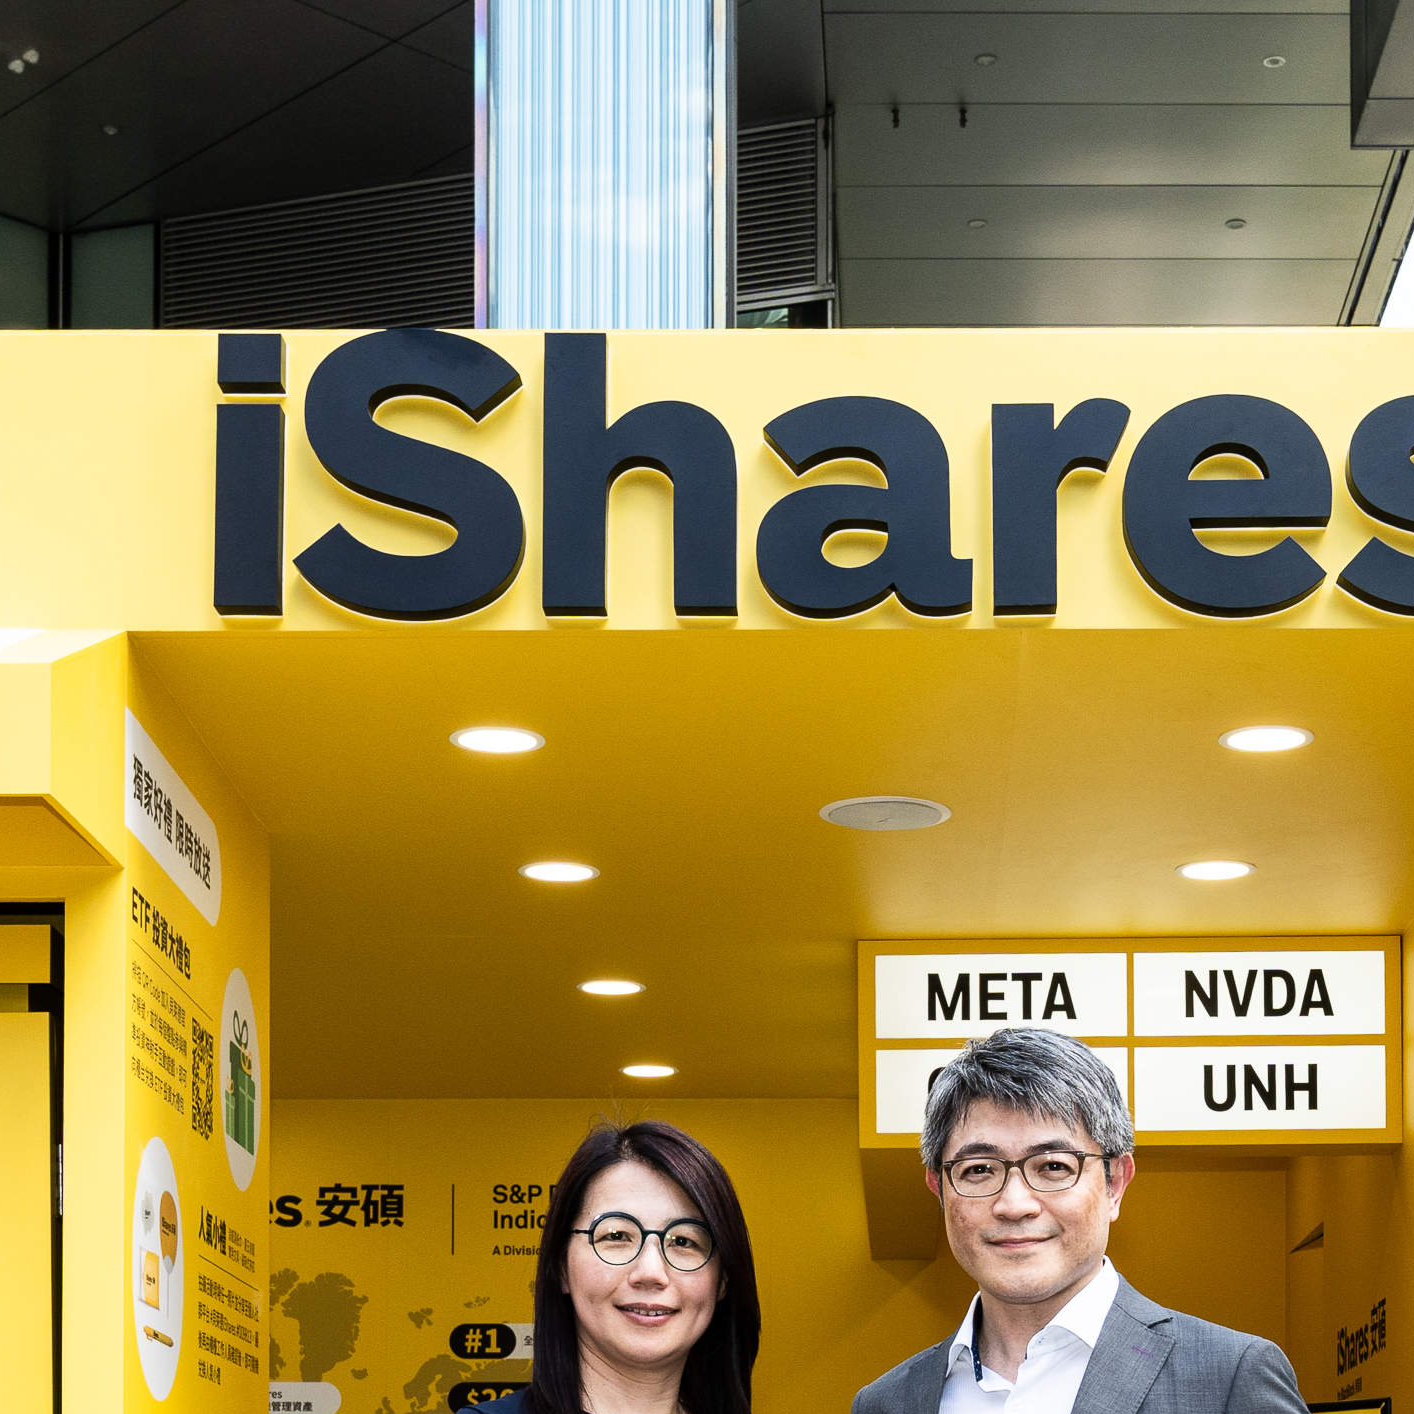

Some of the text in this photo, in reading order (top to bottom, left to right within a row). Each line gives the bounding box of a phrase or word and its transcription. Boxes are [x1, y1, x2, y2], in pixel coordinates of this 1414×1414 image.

[133, 754, 211, 890] 獨家好禮 限時放送
[132, 886, 192, 981] ETF 投資大禮包
[927, 968, 1335, 1022] META NVDA
[1203, 1062, 1319, 1112] UNH
[316, 1183, 404, 1228] 安碩
[492, 1184, 542, 1204] S&P
[198, 1205, 227, 1257] 人氣小禮
[492, 1245, 501, 1256] A
[465, 1328, 502, 1354] #1
[1337, 1297, 1386, 1377] iShares 安碩
[269, 1401, 314, 1412] 管理資產
